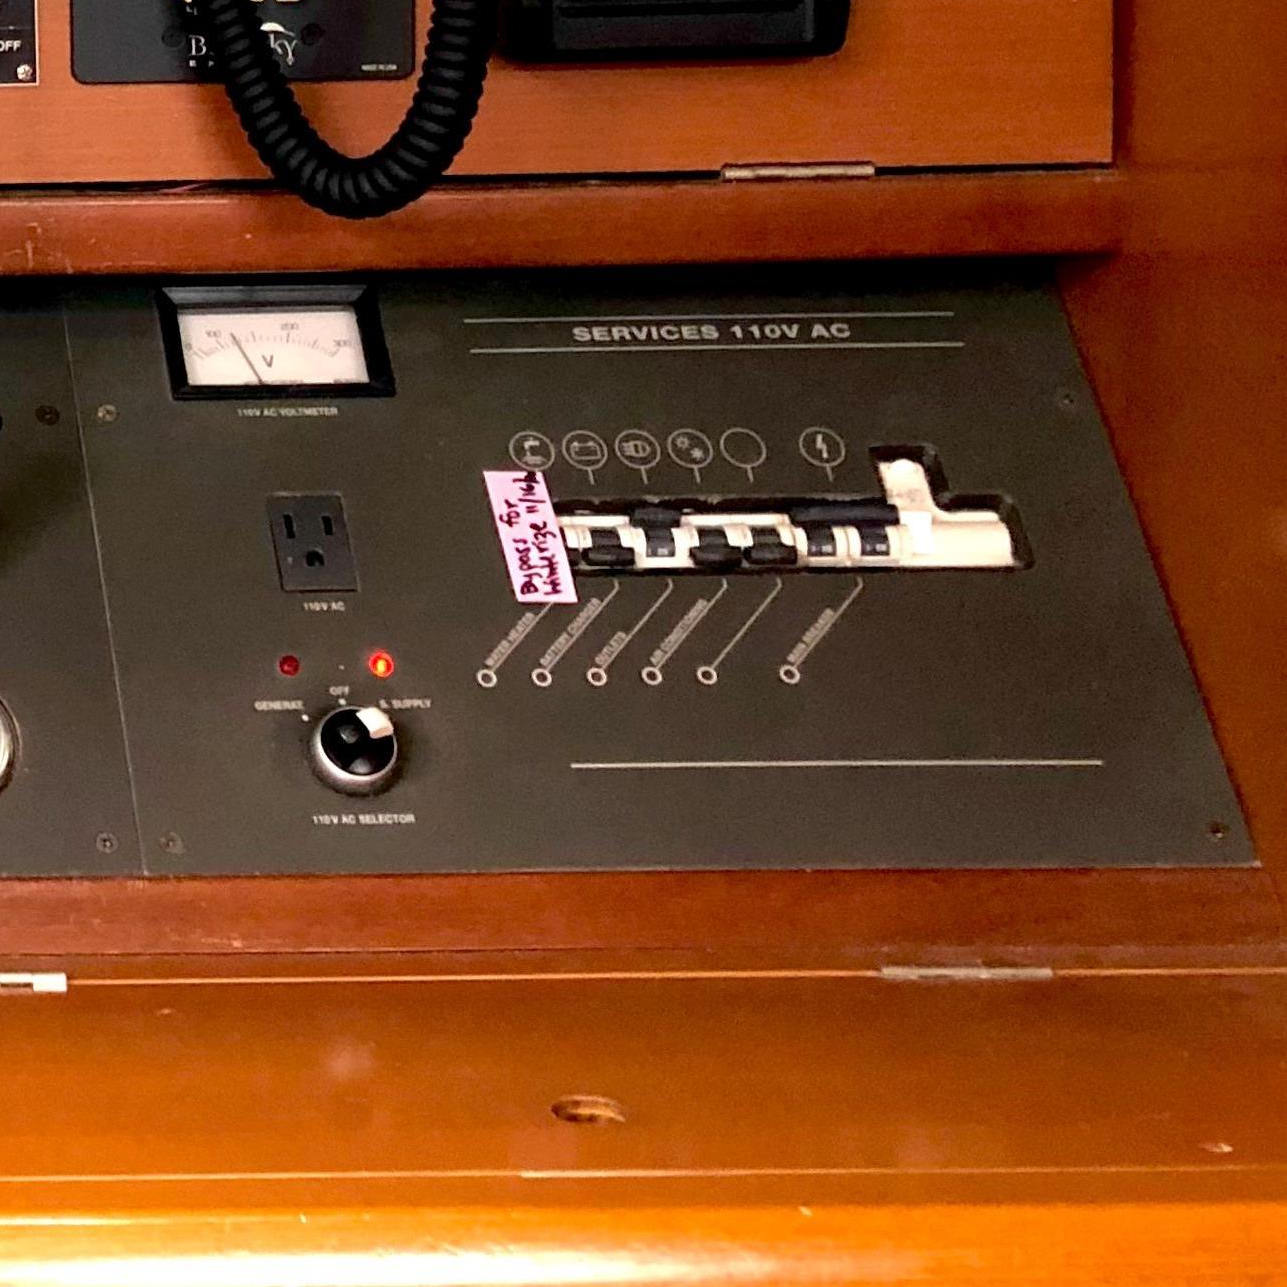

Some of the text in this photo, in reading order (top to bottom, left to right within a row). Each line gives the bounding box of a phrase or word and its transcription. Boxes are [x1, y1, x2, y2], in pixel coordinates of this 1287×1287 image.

[572, 323, 850, 341] SERVICES 110V AC
[261, 354, 274, 368] V
[280, 406, 339, 417] VOLTMETER
[499, 499, 521, 528] for
[331, 600, 346, 611] AC
[594, 630, 628, 666] OUTLETS
[329, 685, 350, 696] OFF
[392, 698, 432, 710] SUPPLY
[342, 814, 357, 825] AC
[358, 813, 416, 825] SELECTOR
